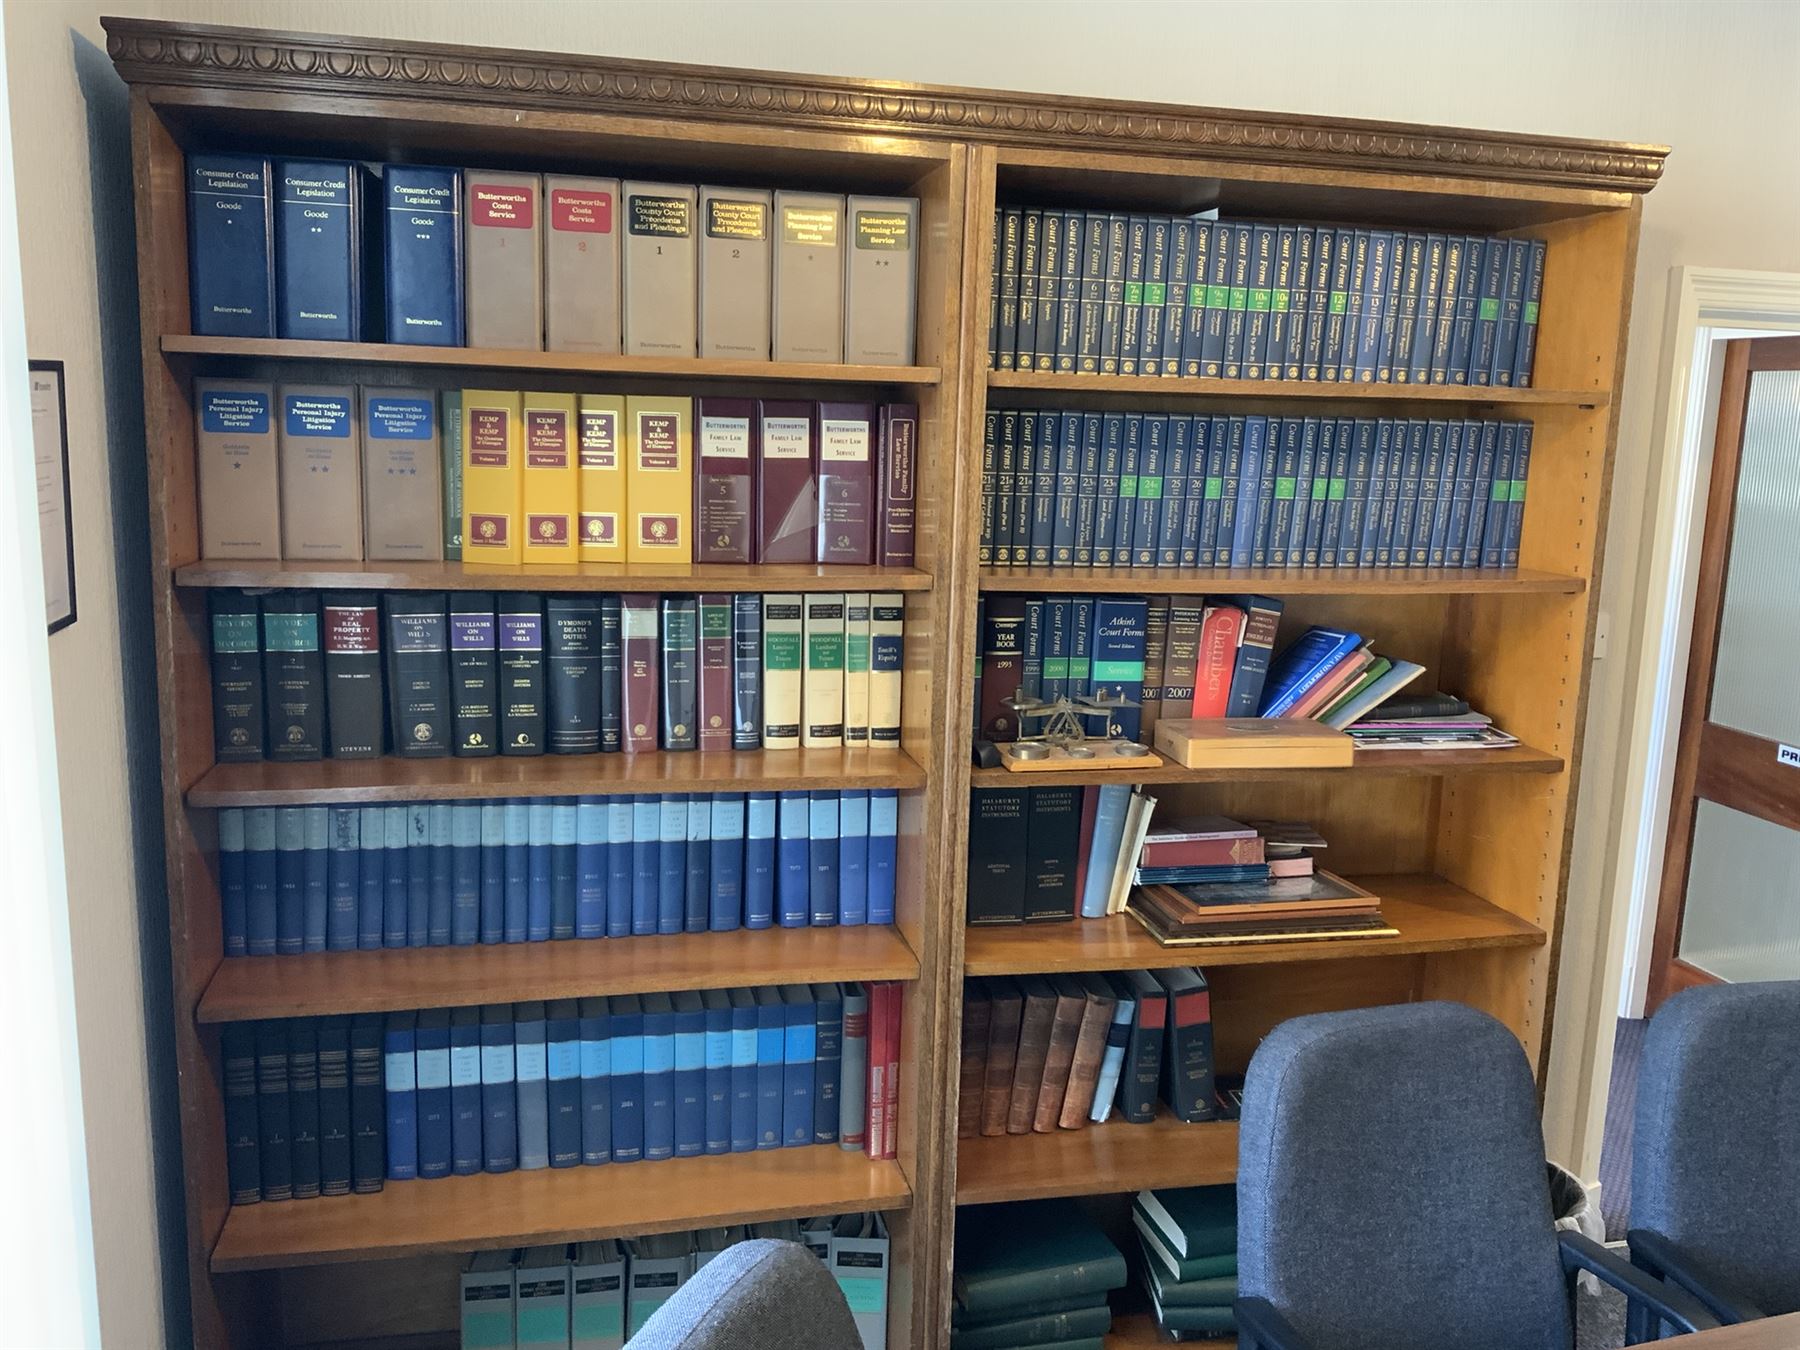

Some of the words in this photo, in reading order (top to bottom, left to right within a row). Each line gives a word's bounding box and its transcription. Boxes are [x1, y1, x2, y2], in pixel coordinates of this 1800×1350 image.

[196, 169, 234, 178] Consumer
[236, 172, 258, 180] Credit
[209, 179, 248, 189] Legislation
[285, 178, 322, 187] Consumer
[297, 188, 335, 197] Legislation
[394, 186, 428, 195] Consumer
[429, 188, 450, 196] Credit
[405, 196, 440, 205] Legislation
[478, 192, 526, 202] Butterworths
[216, 201, 242, 210] Goode
[558, 197, 606, 207] Butterworths
[635, 200, 685, 209] Butterworths
[636, 207, 662, 216] County
[663, 209, 685, 217] Court
[713, 203, 761, 212] Butterworths
[304, 210, 328, 218] Goode
[489, 210, 516, 219] Service
[713, 210, 738, 219] County
[411, 217, 434, 225] Goode
[569, 215, 595, 223] Service
[640, 216, 681, 224] Precedents
[717, 218, 756, 227] Precedents
[861, 217, 906, 225] Butterworths
[650, 224, 686, 233] Pleadings
[727, 227, 761, 236] Pleadings
[861, 226, 890, 235] Planning
[1008, 216, 1017, 242] Court
[1028, 216, 1037, 241] Court
[1049, 218, 1058, 243] Court
[1069, 219, 1078, 245] Court
[657, 246, 662, 255] 1
[732, 249, 740, 258] 2
[1432, 242, 1441, 266] Court
[1451, 243, 1460, 267] Court
[1006, 244, 1016, 272] Forms
[1026, 244, 1036, 271] Forms
[1047, 246, 1057, 272] Forms
[1068, 247, 1077, 274] Forms
[1008, 279, 1013, 287] 3
[1027, 278, 1032, 287] 4
[1048, 280, 1053, 289] 5
[1429, 269, 1439, 294] Forms
[1447, 270, 1457, 294] Forms
[214, 306, 252, 314] Butterworths
[300, 311, 337, 319] Butterworths
[406, 317, 442, 326] Butterworths
[1177, 422, 1185, 445] Court
[1198, 422, 1206, 445] Court
[1233, 422, 1242, 446] Court
[1361, 425, 1370, 448] Court
[1173, 449, 1183, 474] Forms
[1194, 448, 1204, 473] Forms
[1230, 449, 1240, 474] Forms
[1357, 452, 1368, 475] Forms
[1171, 480, 1180, 488] 25
[1192, 480, 1201, 488] 26
[1354, 482, 1363, 490] 31
[720, 486, 726, 495] 5
[842, 489, 848, 498] 6
[1109, 617, 1136, 626] Atkin's
[1099, 627, 1121, 636] Court
[1122, 628, 1144, 637] Forms
[1209, 616, 1233, 701] Chambers
[1107, 665, 1134, 674] Service
[1142, 688, 1160, 698] 2007
[1168, 688, 1191, 698] 2007
